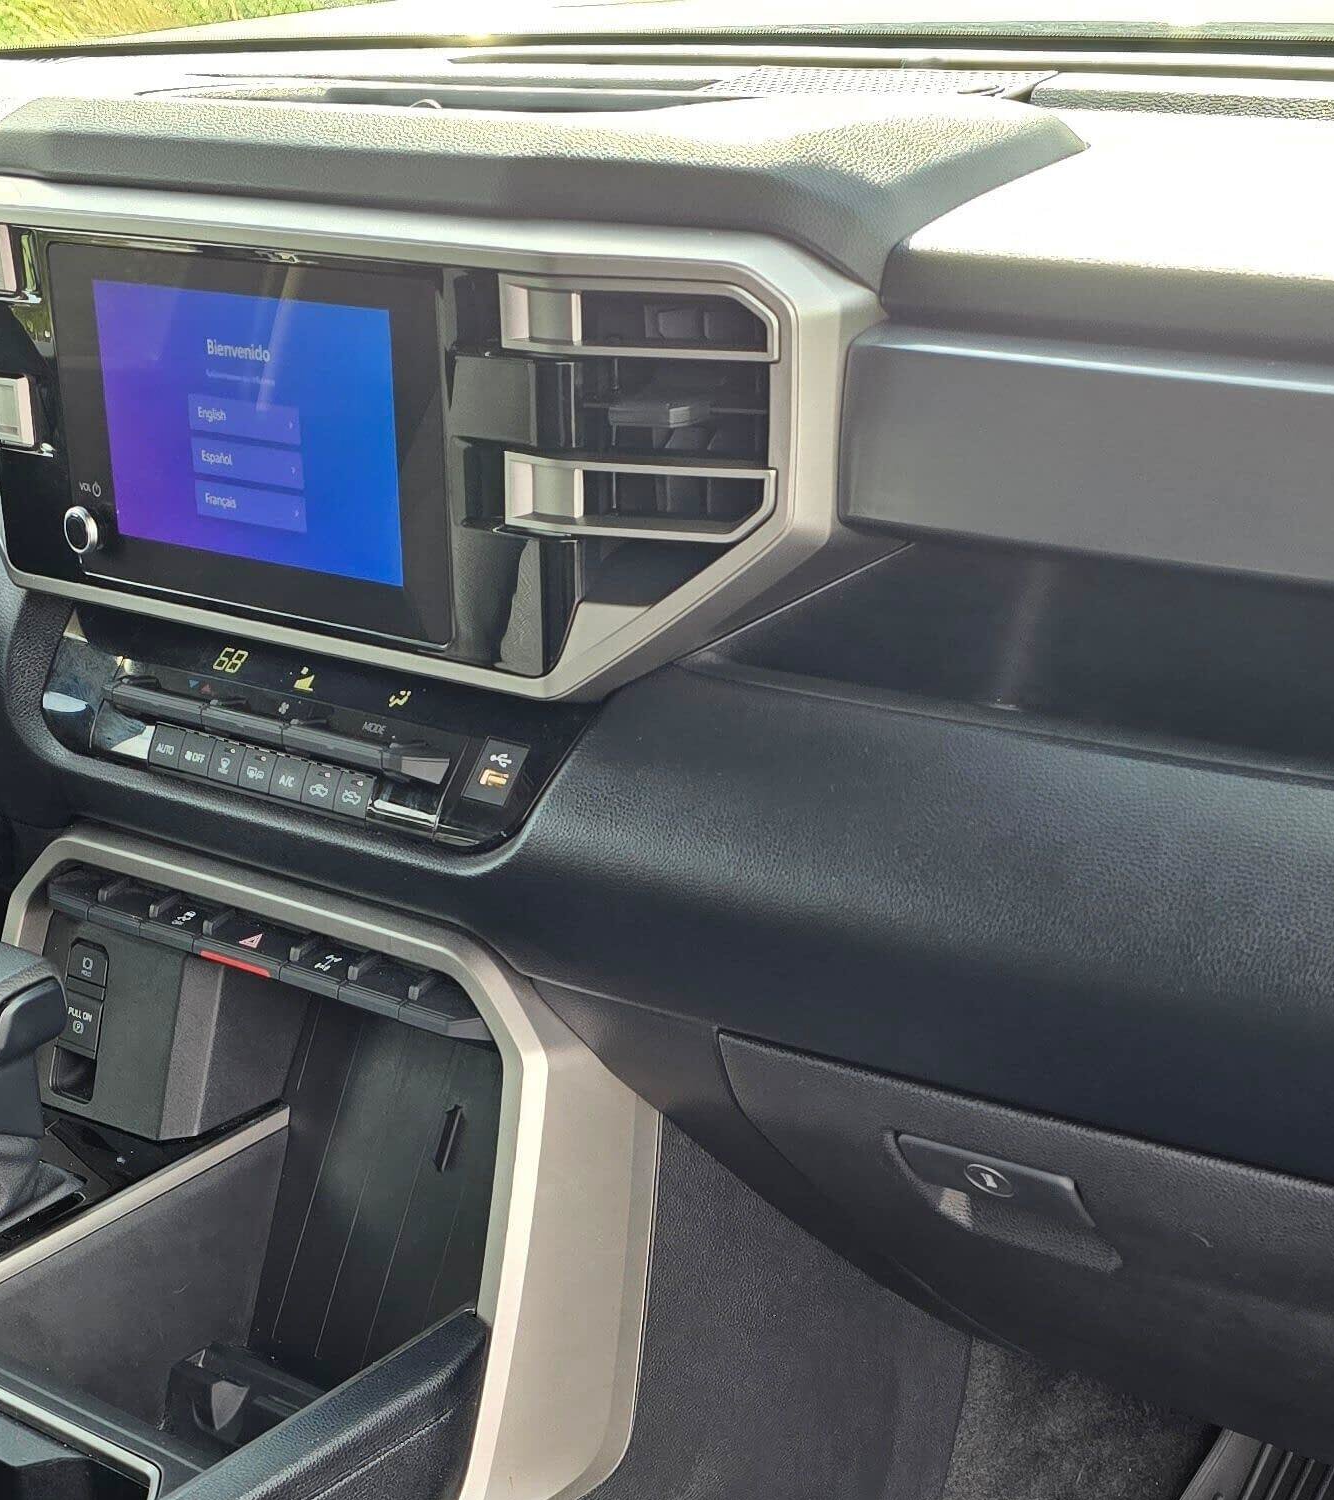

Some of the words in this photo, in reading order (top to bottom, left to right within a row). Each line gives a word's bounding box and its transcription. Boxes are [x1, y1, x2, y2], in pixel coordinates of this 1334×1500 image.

[206, 338, 272, 362] Bienvenido
[197, 406, 227, 423] English
[201, 449, 233, 466] Español
[204, 492, 237, 509] Français
[213, 647, 249, 673] 68
[155, 742, 175, 756] AUTO
[192, 752, 206, 764] OFF
[278, 774, 295, 788] A/C
[68, 1006, 81, 1019] PULL
[82, 1011, 92, 1022] ON
